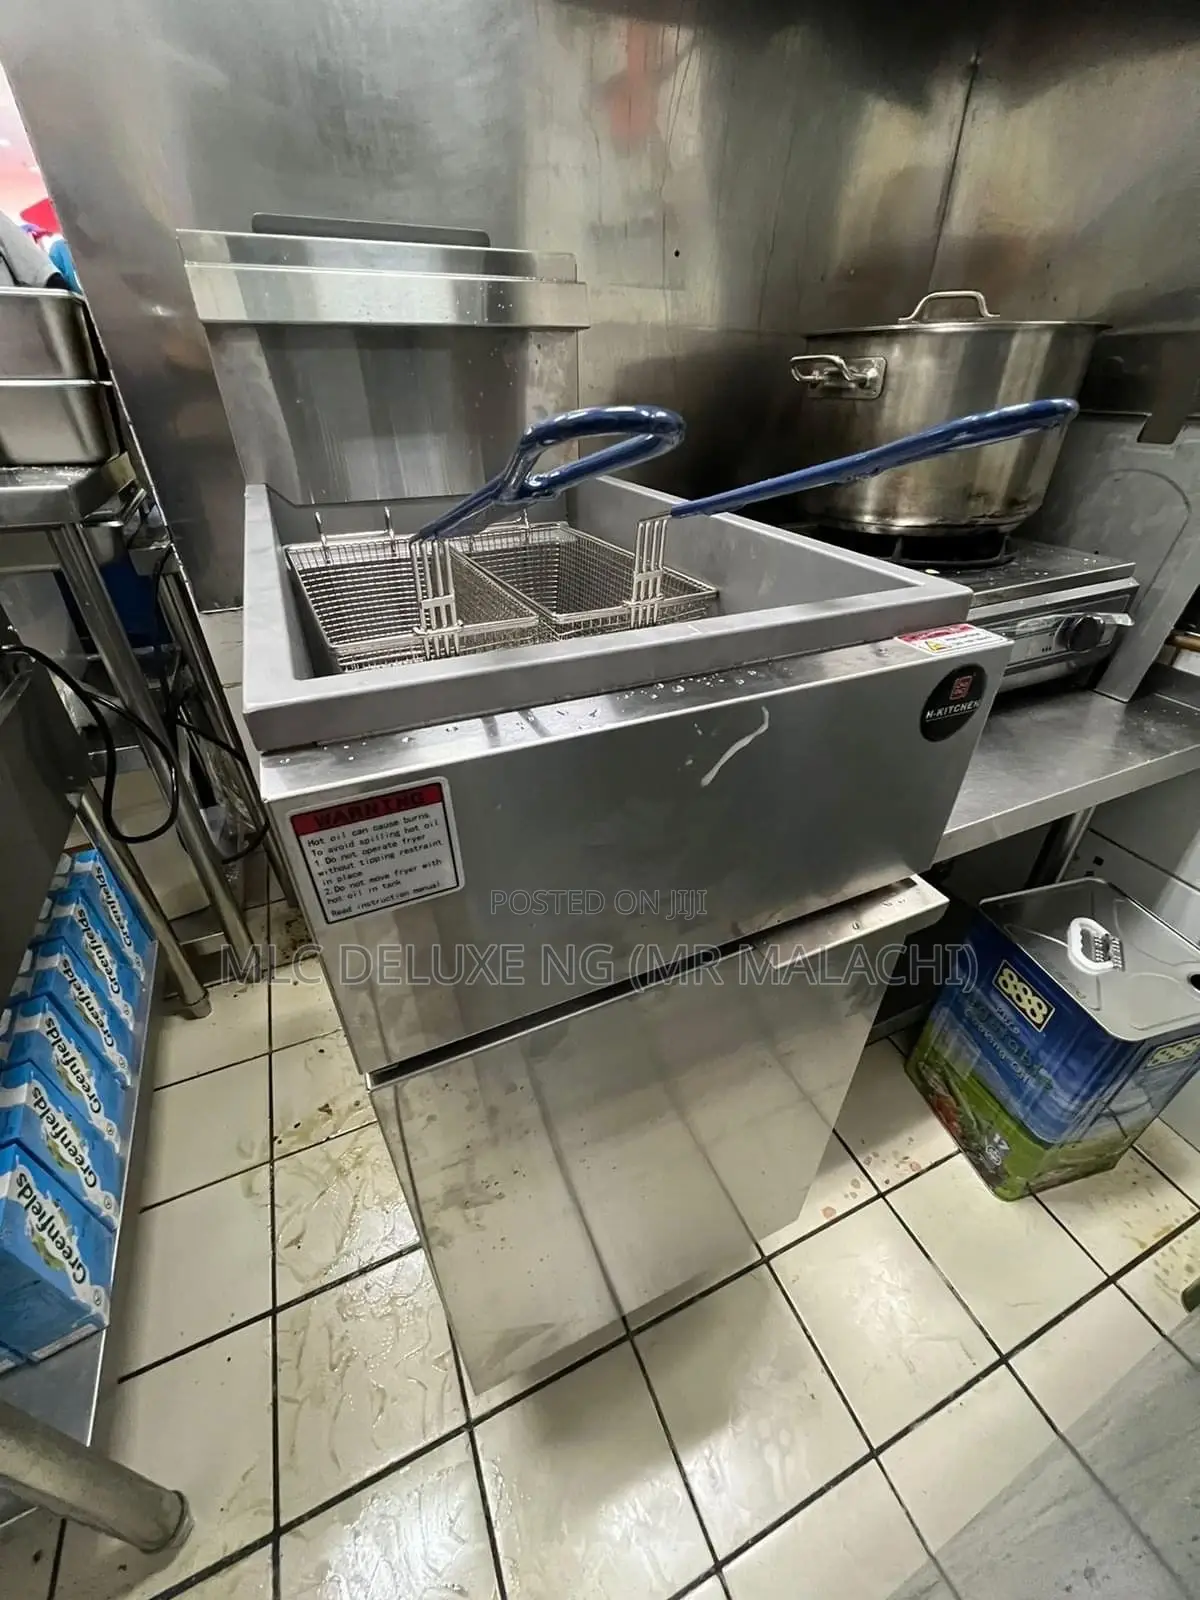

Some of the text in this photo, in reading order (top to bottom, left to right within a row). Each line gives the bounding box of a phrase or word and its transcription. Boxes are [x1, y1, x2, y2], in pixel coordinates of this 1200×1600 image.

[314, 791, 425, 828] WARNING
[308, 838, 324, 848] Hot
[330, 832, 346, 842] oil
[352, 828, 369, 837] can
[373, 820, 400, 832] cause
[312, 820, 439, 857] To avoid spilling hot oil
[341, 851, 357, 861] not
[361, 842, 398, 855] operate
[402, 834, 426, 845] fryer
[318, 840, 443, 876] without tipping restraint
[349, 880, 365, 889] not
[369, 874, 390, 883] move
[394, 866, 417, 877] fryer
[421, 859, 442, 870] with
[337, 871, 363, 883] place
[347, 890, 362, 900] oil
[95, 865, 132, 949] Greenfields
[76, 907, 121, 995] Greenfields
[61, 957, 115, 1049] Greenfields
[997, 966, 1049, 1025] 888
[44, 1015, 101, 1114] Greenfields
[31, 1086, 98, 1189] Greenfields
[16, 1171, 86, 1285] Greenfields
